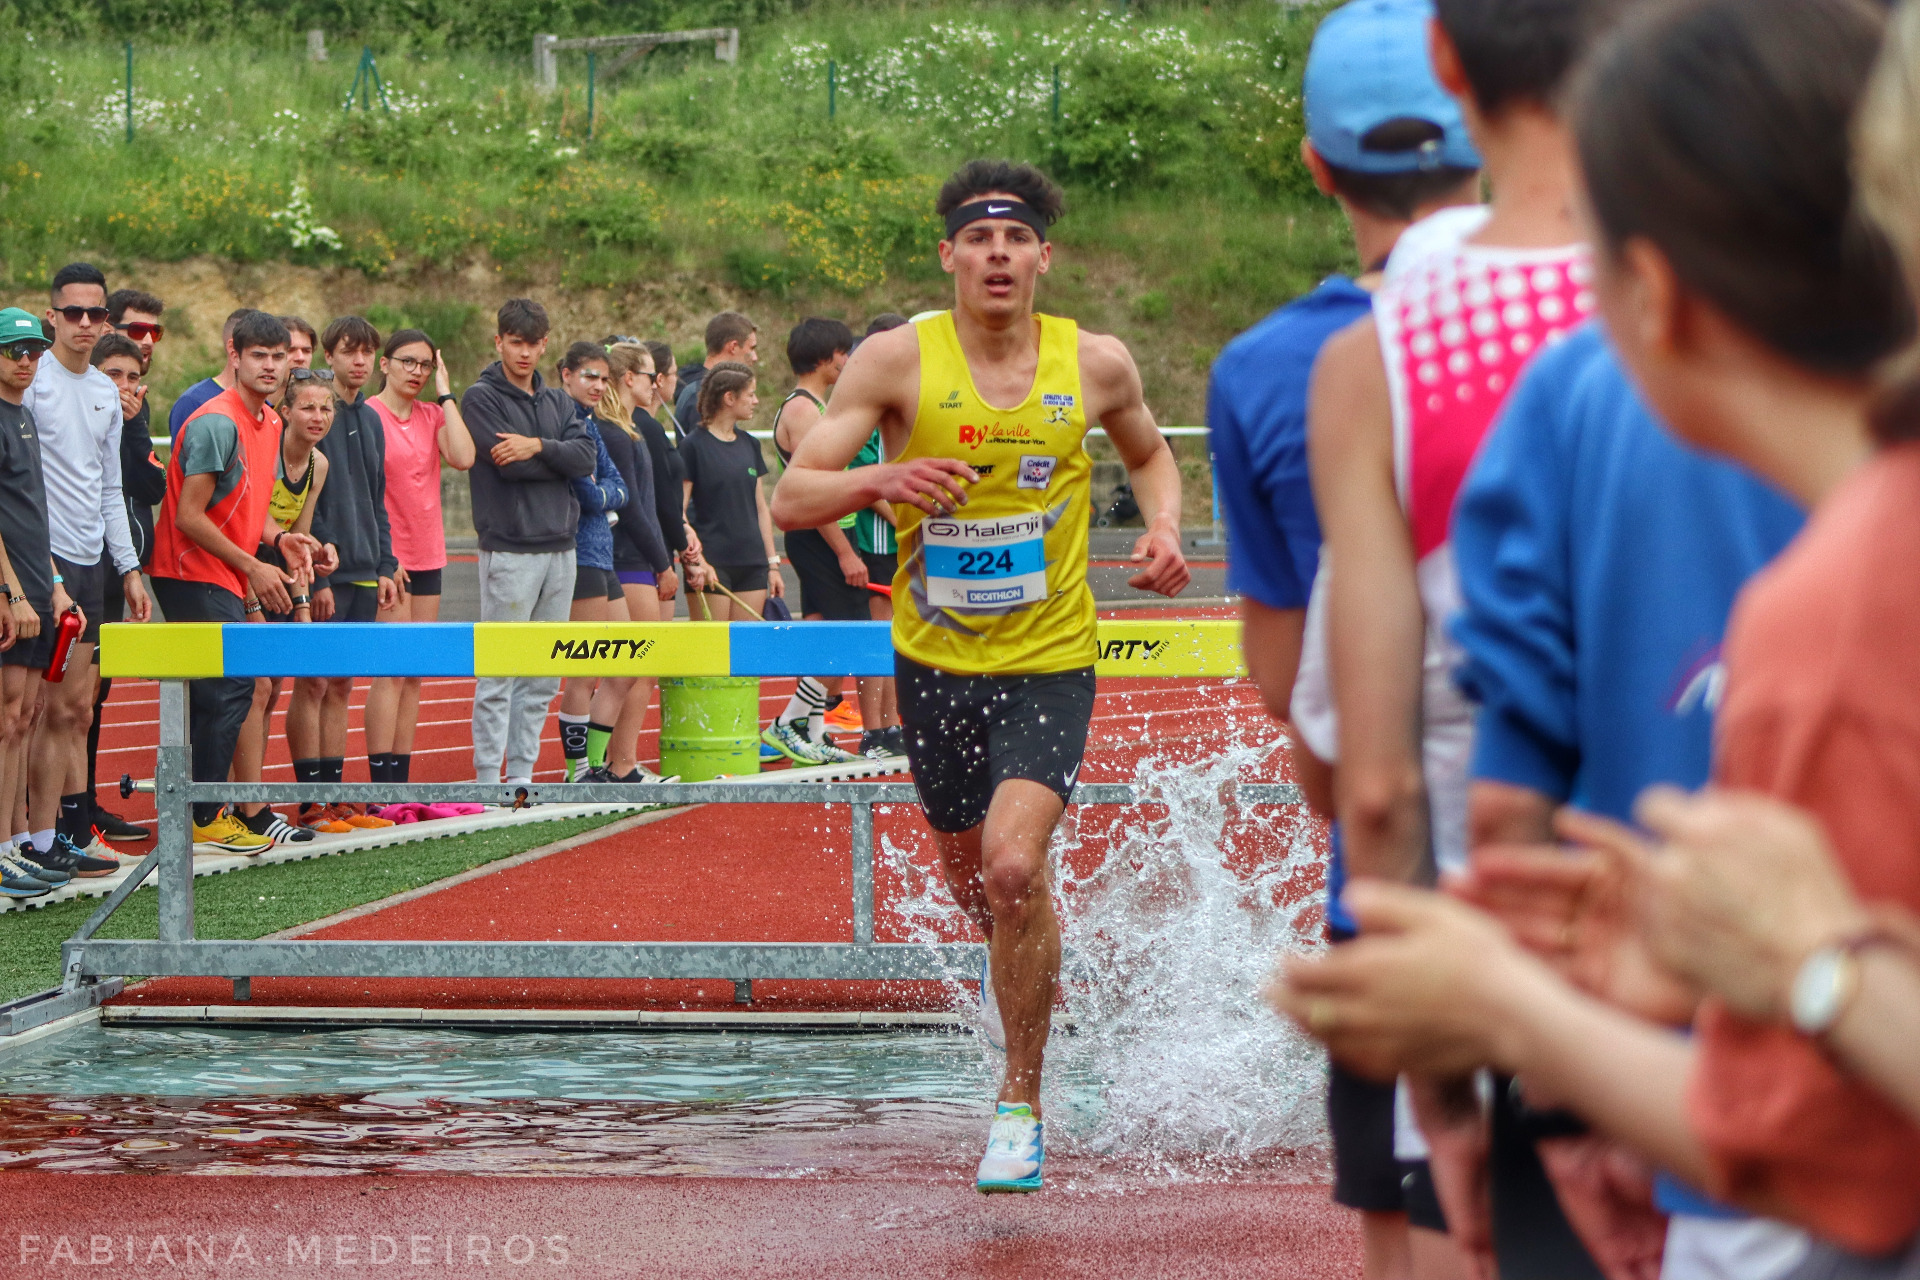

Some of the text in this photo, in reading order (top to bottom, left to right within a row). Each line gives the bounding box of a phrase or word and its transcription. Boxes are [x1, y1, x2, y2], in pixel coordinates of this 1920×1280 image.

[989, 421, 1030, 437] la ville
[1027, 460, 1050, 468] Crédit
[1023, 474, 1047, 483] Mutuel
[964, 516, 1039, 537] Kalenji
[958, 549, 1014, 575] 224
[969, 589, 1022, 602] DECATHLON
[550, 639, 656, 659] MARTY Sports
[566, 725, 588, 751] GO!
